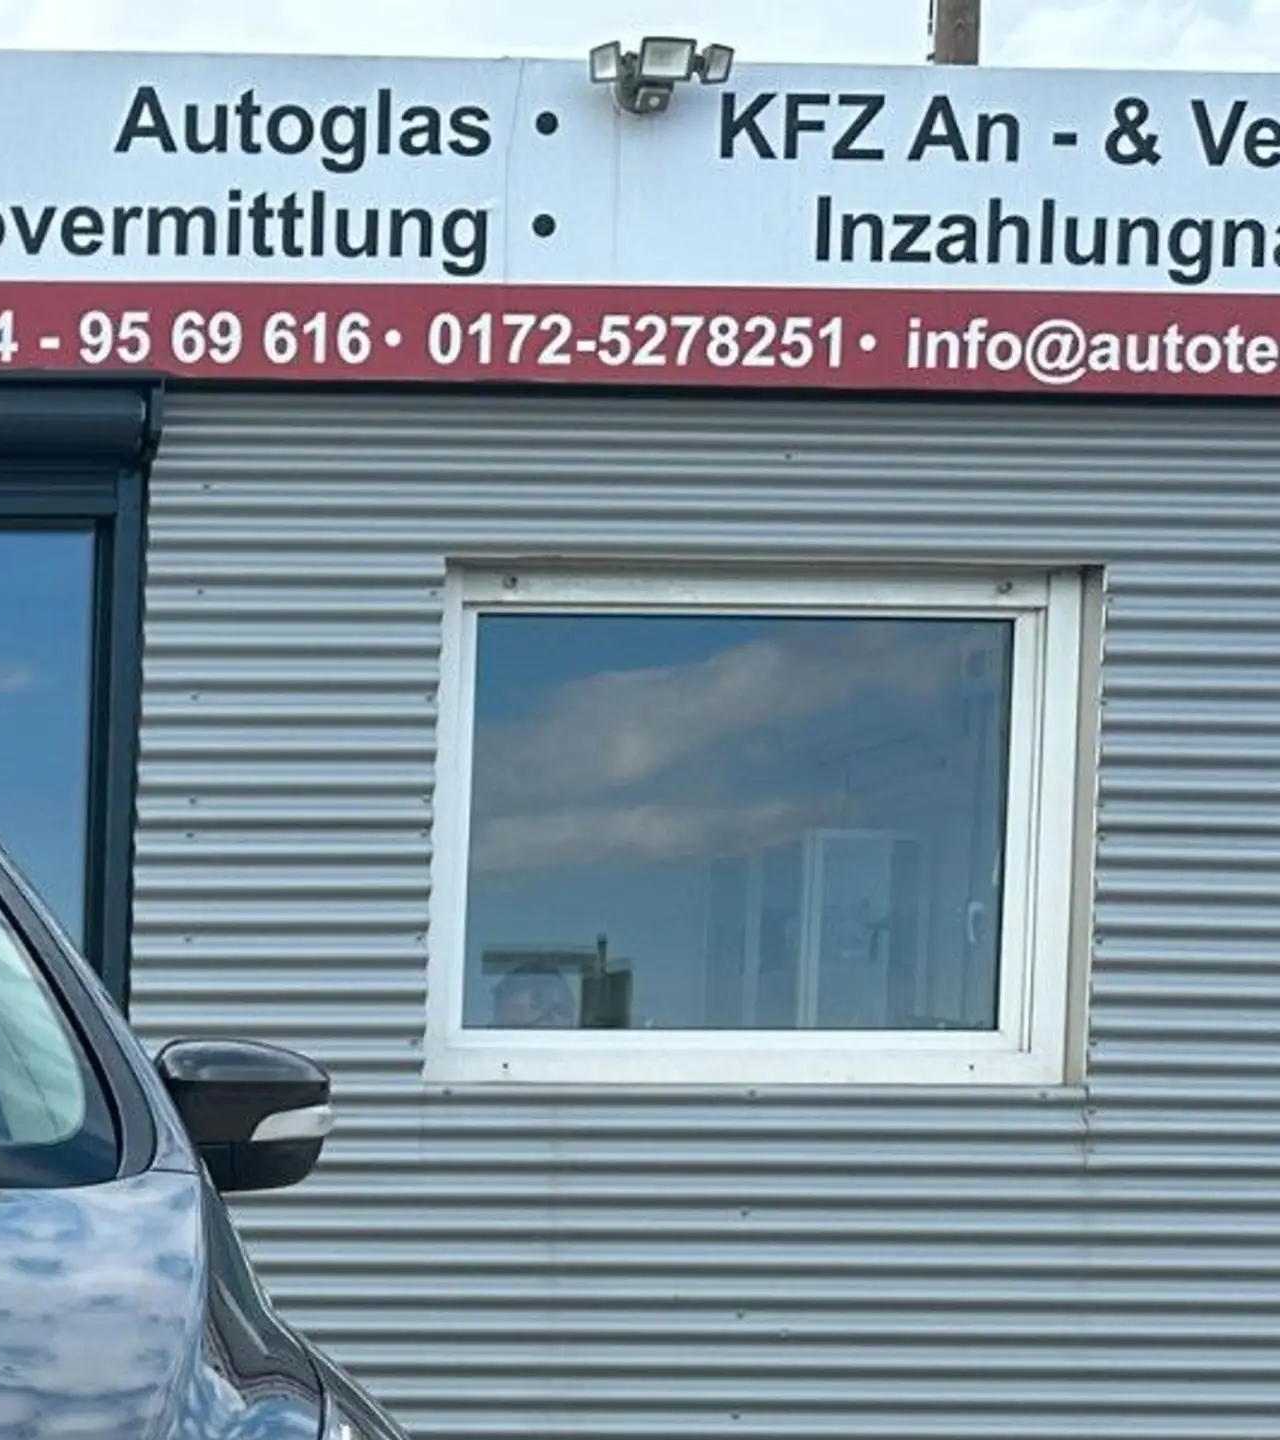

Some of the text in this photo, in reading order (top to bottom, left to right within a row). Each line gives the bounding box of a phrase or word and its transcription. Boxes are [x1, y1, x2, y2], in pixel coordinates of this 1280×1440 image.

[114, 86, 493, 174] Autoglas
[719, 91, 886, 161] KFZ
[907, 95, 1020, 163] An
[1104, 96, 1162, 166] &
[815, 195, 1280, 286] Inzahlungn
[78, 310, 151, 364] 95
[171, 310, 242, 364] 69
[263, 311, 371, 364] 616
[428, 312, 842, 368] 0172-5278251
